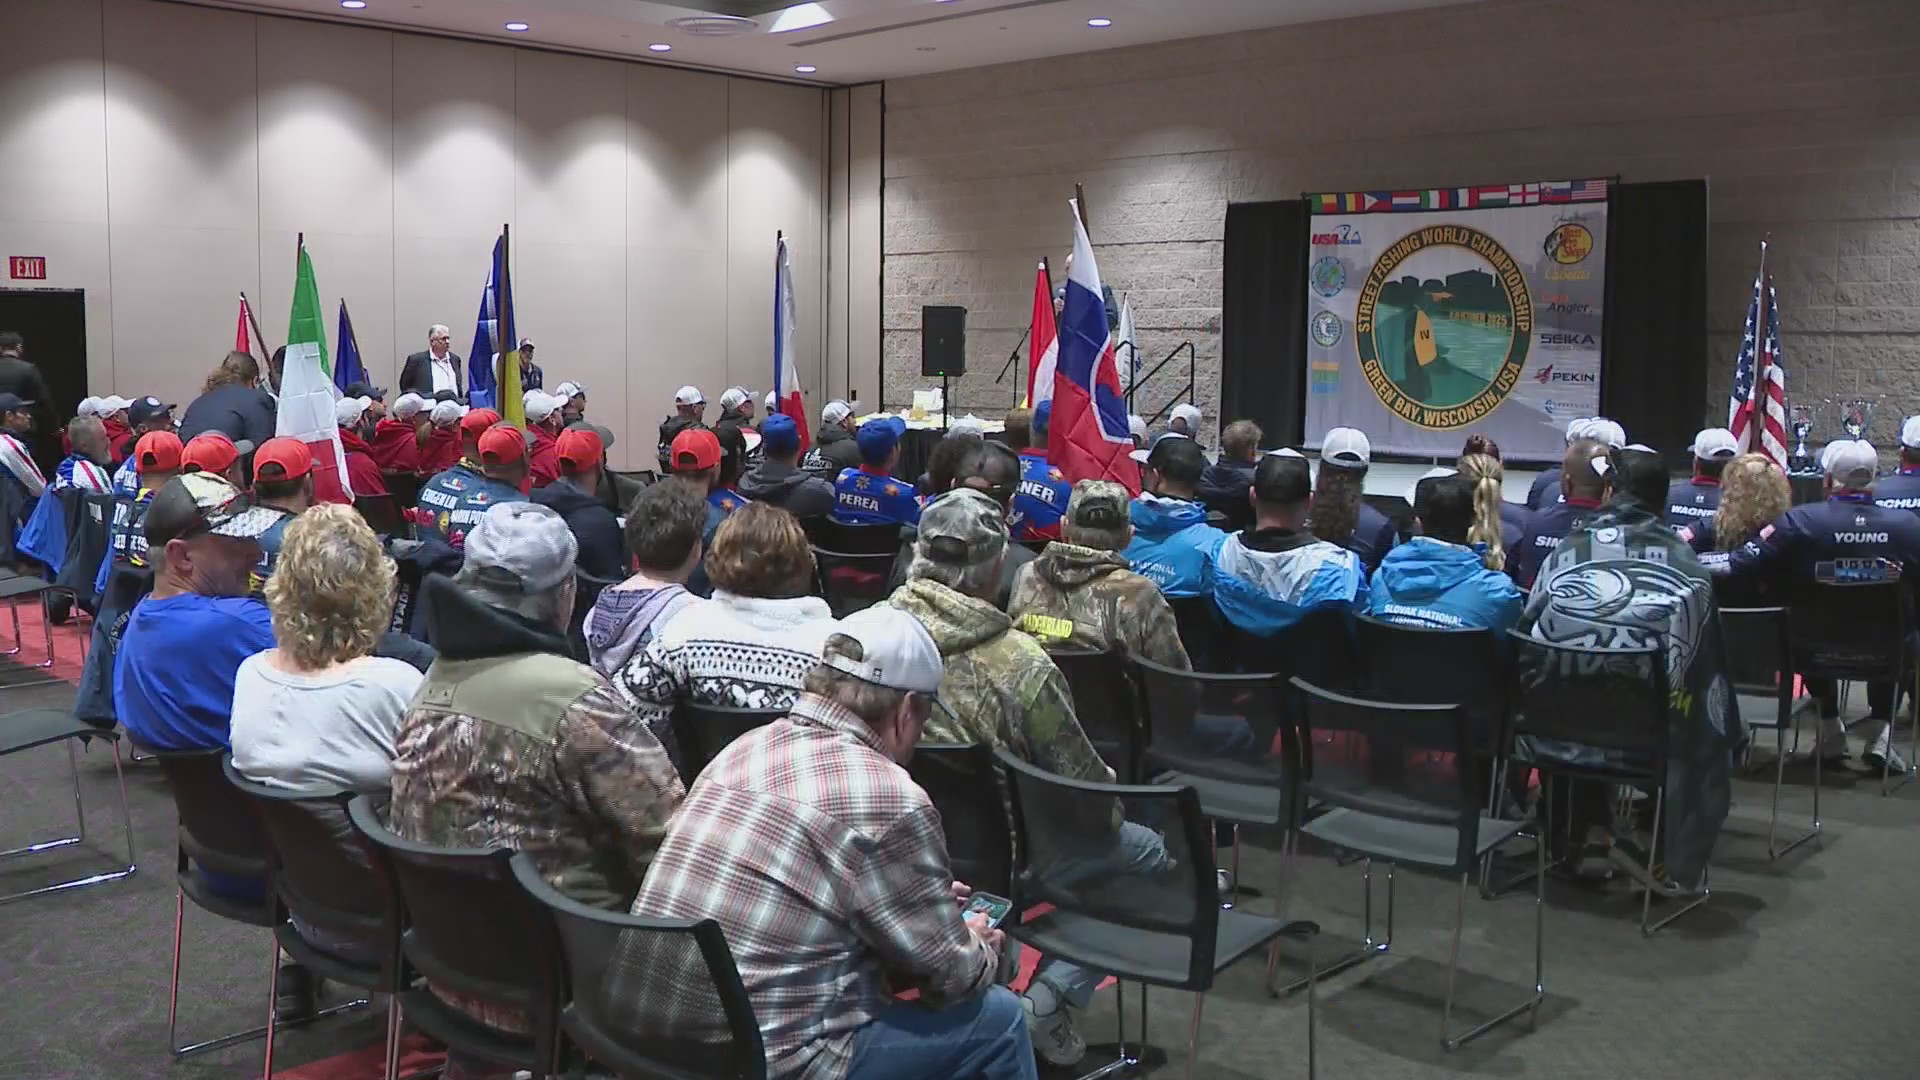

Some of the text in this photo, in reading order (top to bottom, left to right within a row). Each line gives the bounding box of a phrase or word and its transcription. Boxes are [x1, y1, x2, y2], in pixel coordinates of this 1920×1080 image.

[16, 258, 40, 277] EXIT
[1358, 276, 1380, 333] STREET
[1375, 234, 1420, 279] FISHING
[1422, 227, 1470, 246] WORLD
[1471, 232, 1530, 332] CHAMPIONSHIP
[1420, 329, 1430, 340] IV
[1541, 334, 1595, 344] SEIKA
[1552, 372, 1595, 382] PEKIN
[1364, 359, 1397, 402] GREEN
[1394, 396, 1421, 422] BAY,
[1497, 362, 1521, 392] USA
[1015, 480, 1055, 504] NER
[839, 493, 879, 511] PEREA
[1875, 498, 1920, 509] SCHU
[1834, 532, 1888, 543] YOUNG
